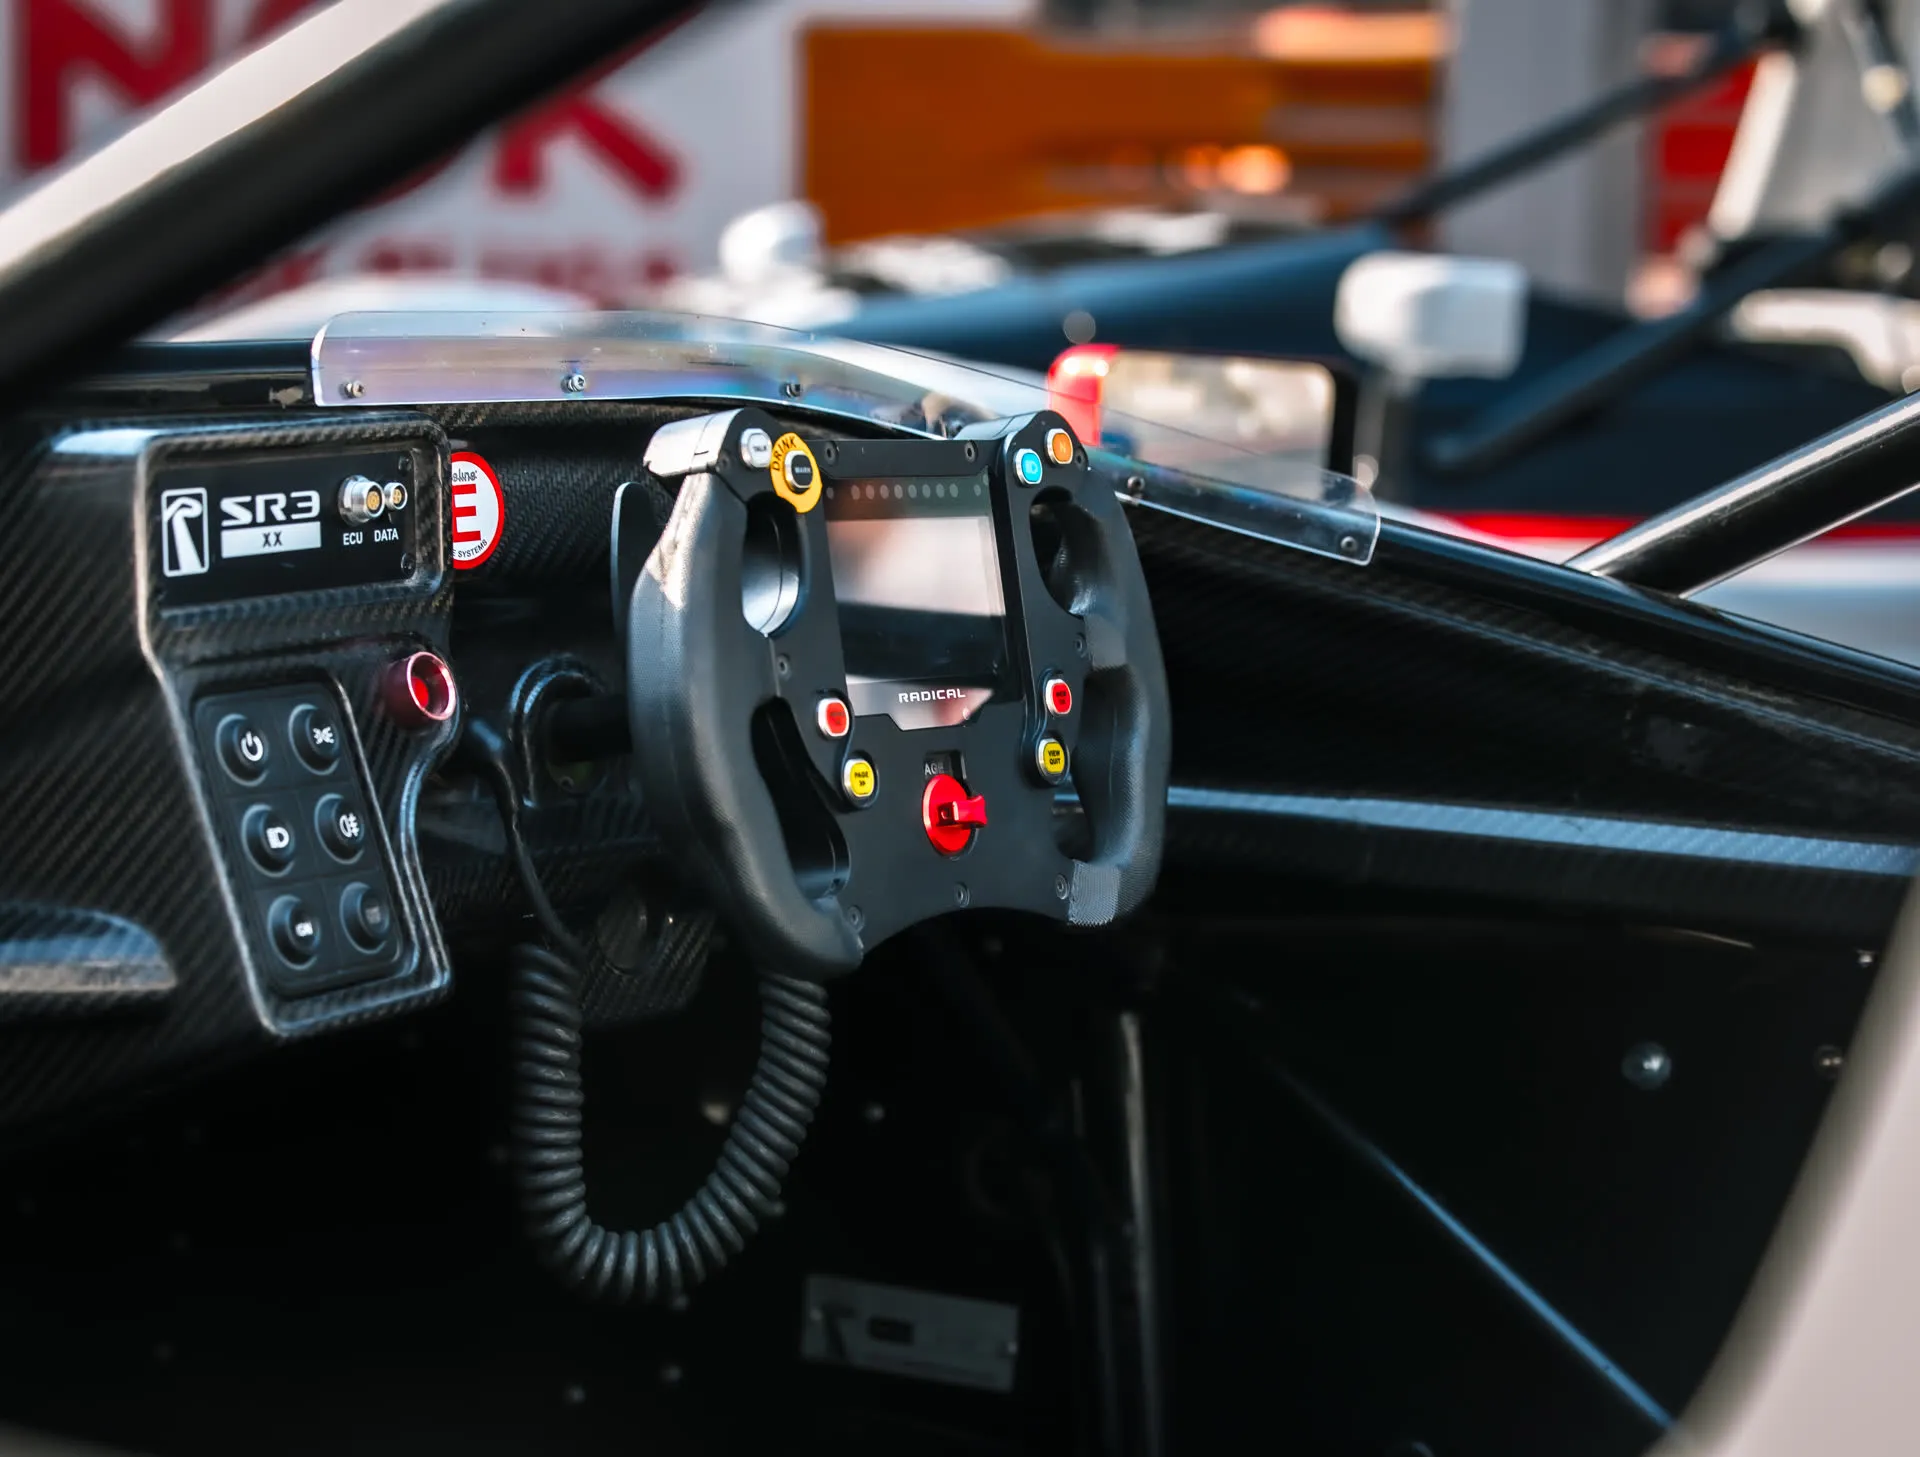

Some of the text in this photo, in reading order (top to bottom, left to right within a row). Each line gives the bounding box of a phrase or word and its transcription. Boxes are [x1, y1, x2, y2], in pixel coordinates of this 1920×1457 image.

[772, 436, 797, 471] DRINK
[220, 490, 321, 527] SR3
[262, 532, 283, 547] XX
[343, 528, 399, 545] ECU DATA
[457, 538, 488, 558] SYSTEMS
[898, 688, 966, 703] RADICAL
